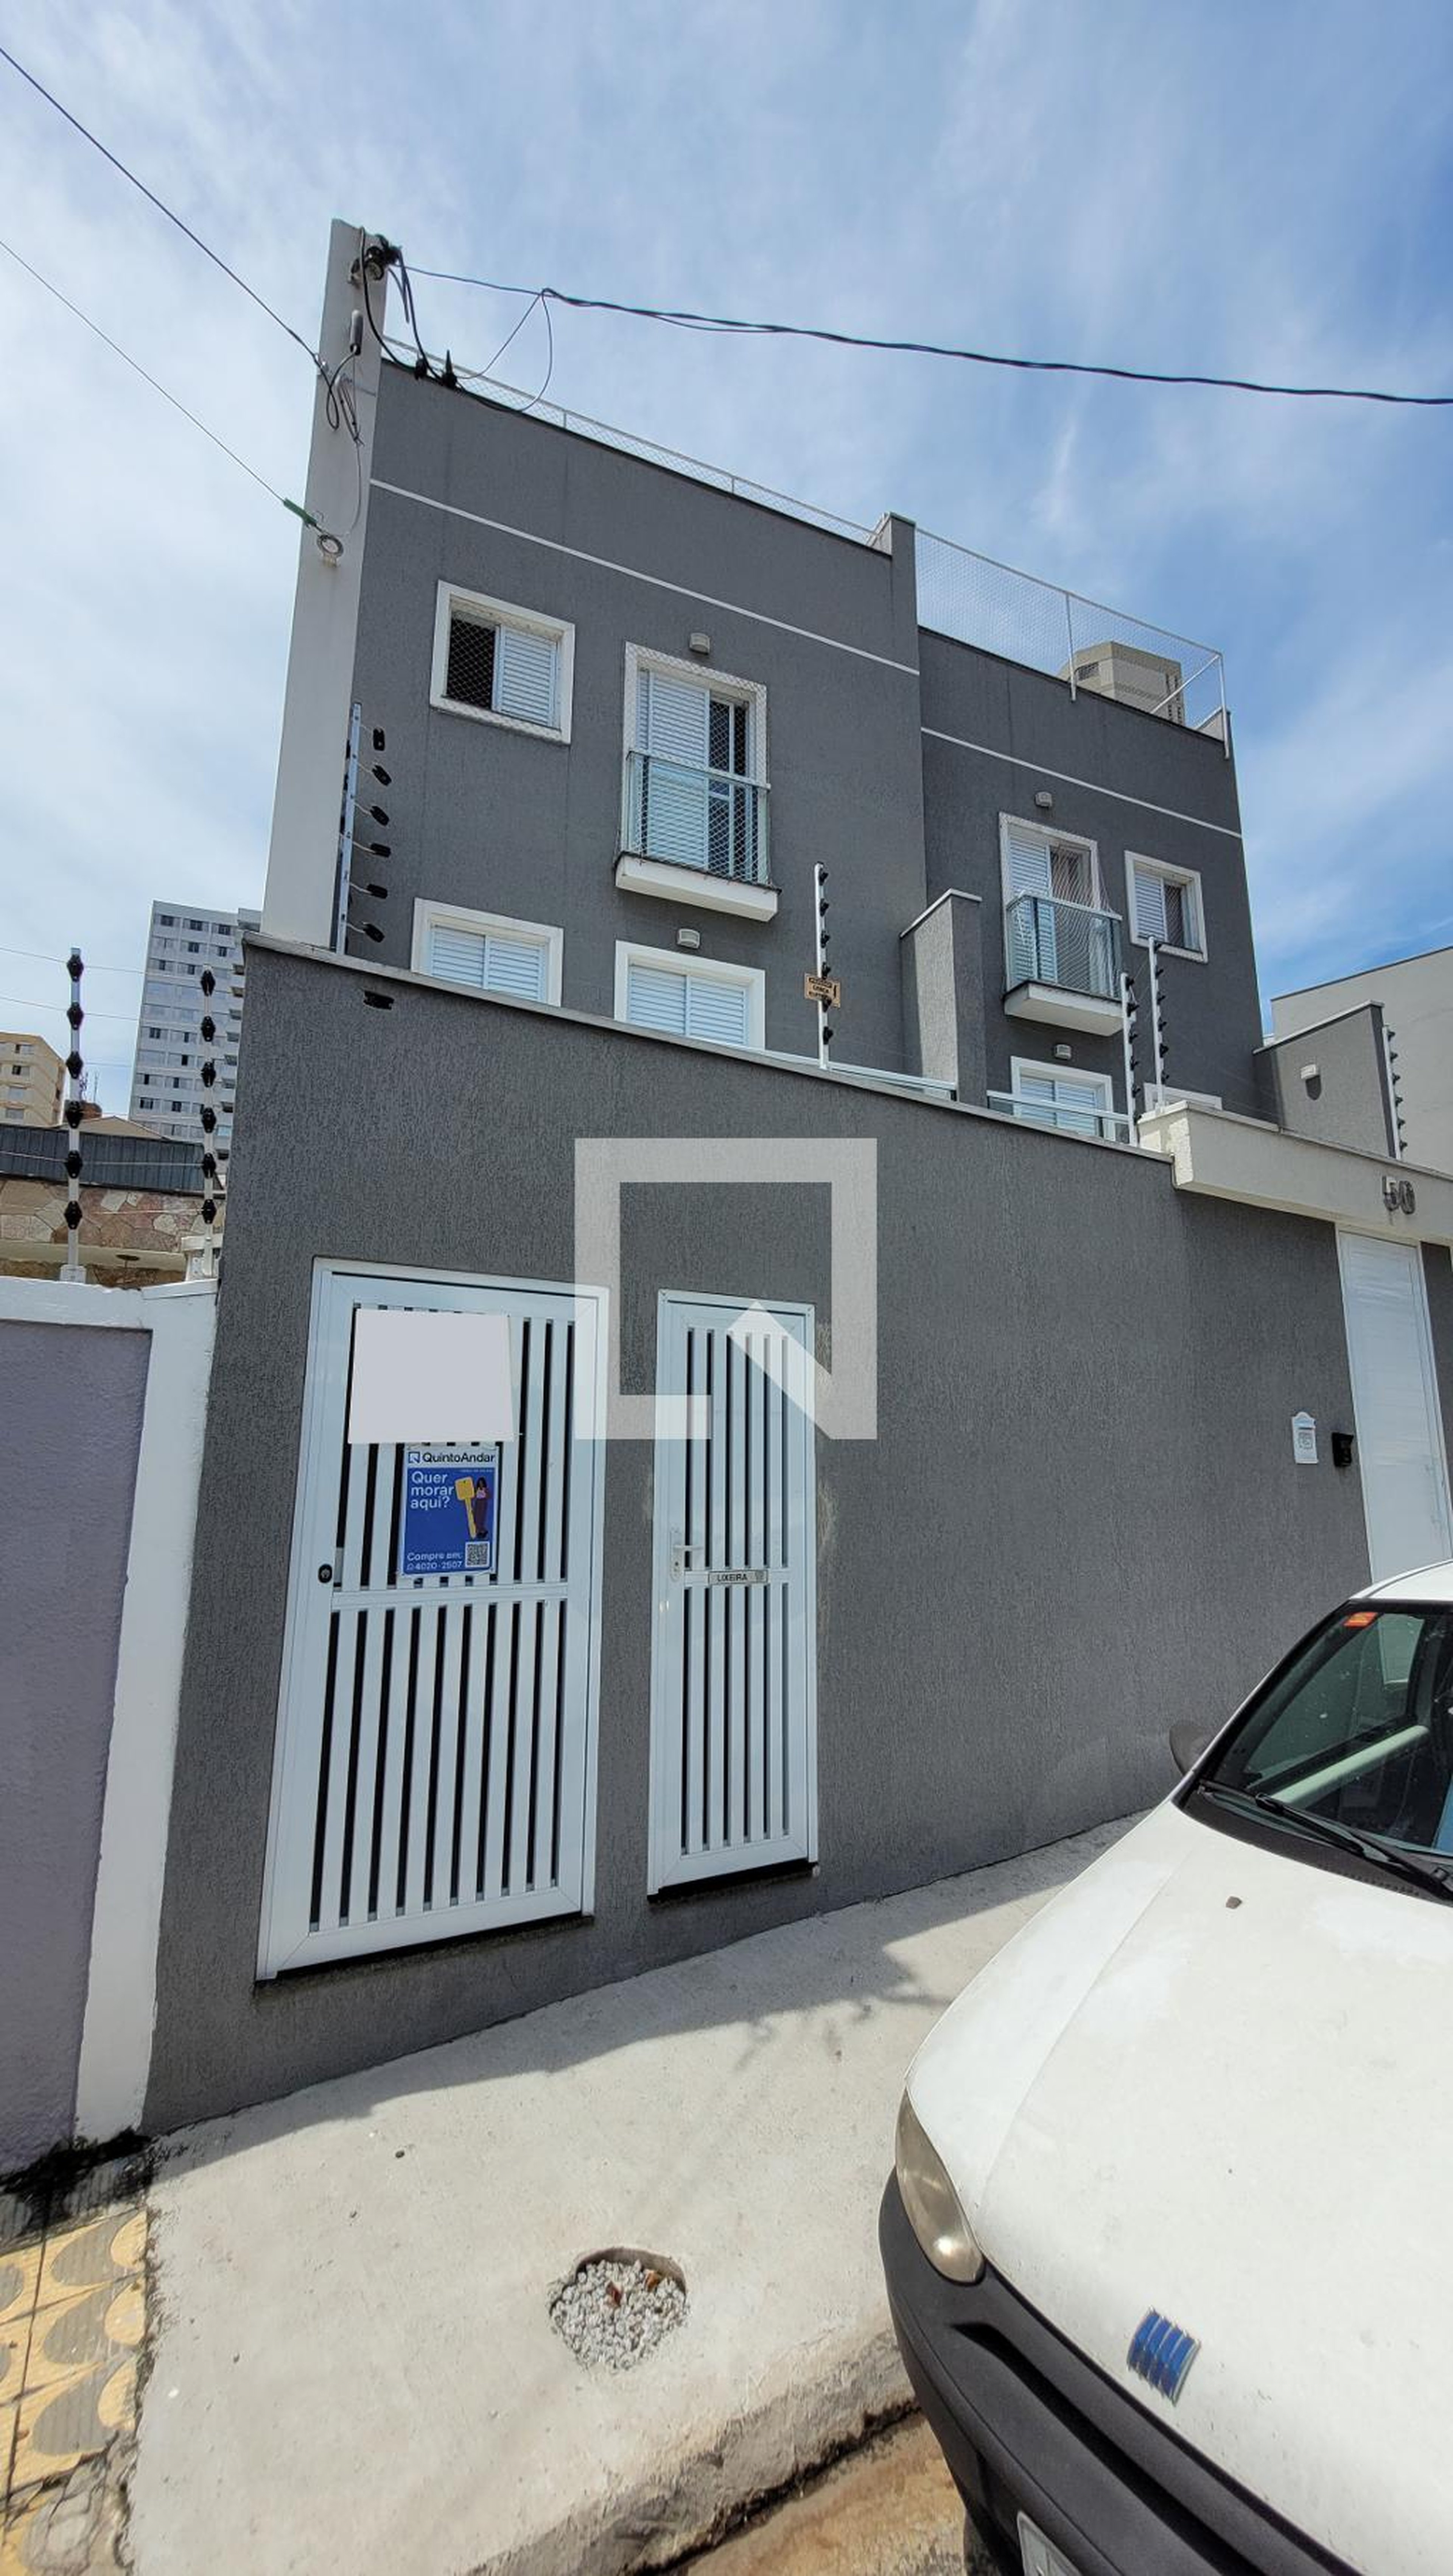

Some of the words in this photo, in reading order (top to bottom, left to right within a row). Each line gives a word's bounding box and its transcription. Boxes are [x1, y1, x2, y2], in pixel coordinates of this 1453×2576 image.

[1382, 1176, 1415, 1215] 50
[423, 1453, 495, 1462] QuintoAndar
[412, 1471, 448, 1484] Quer
[411, 1486, 454, 1496] morar
[410, 1496, 450, 1511] aqui?
[407, 1552, 444, 1561] Compre
[718, 1573, 748, 1582] LIXEIRA
